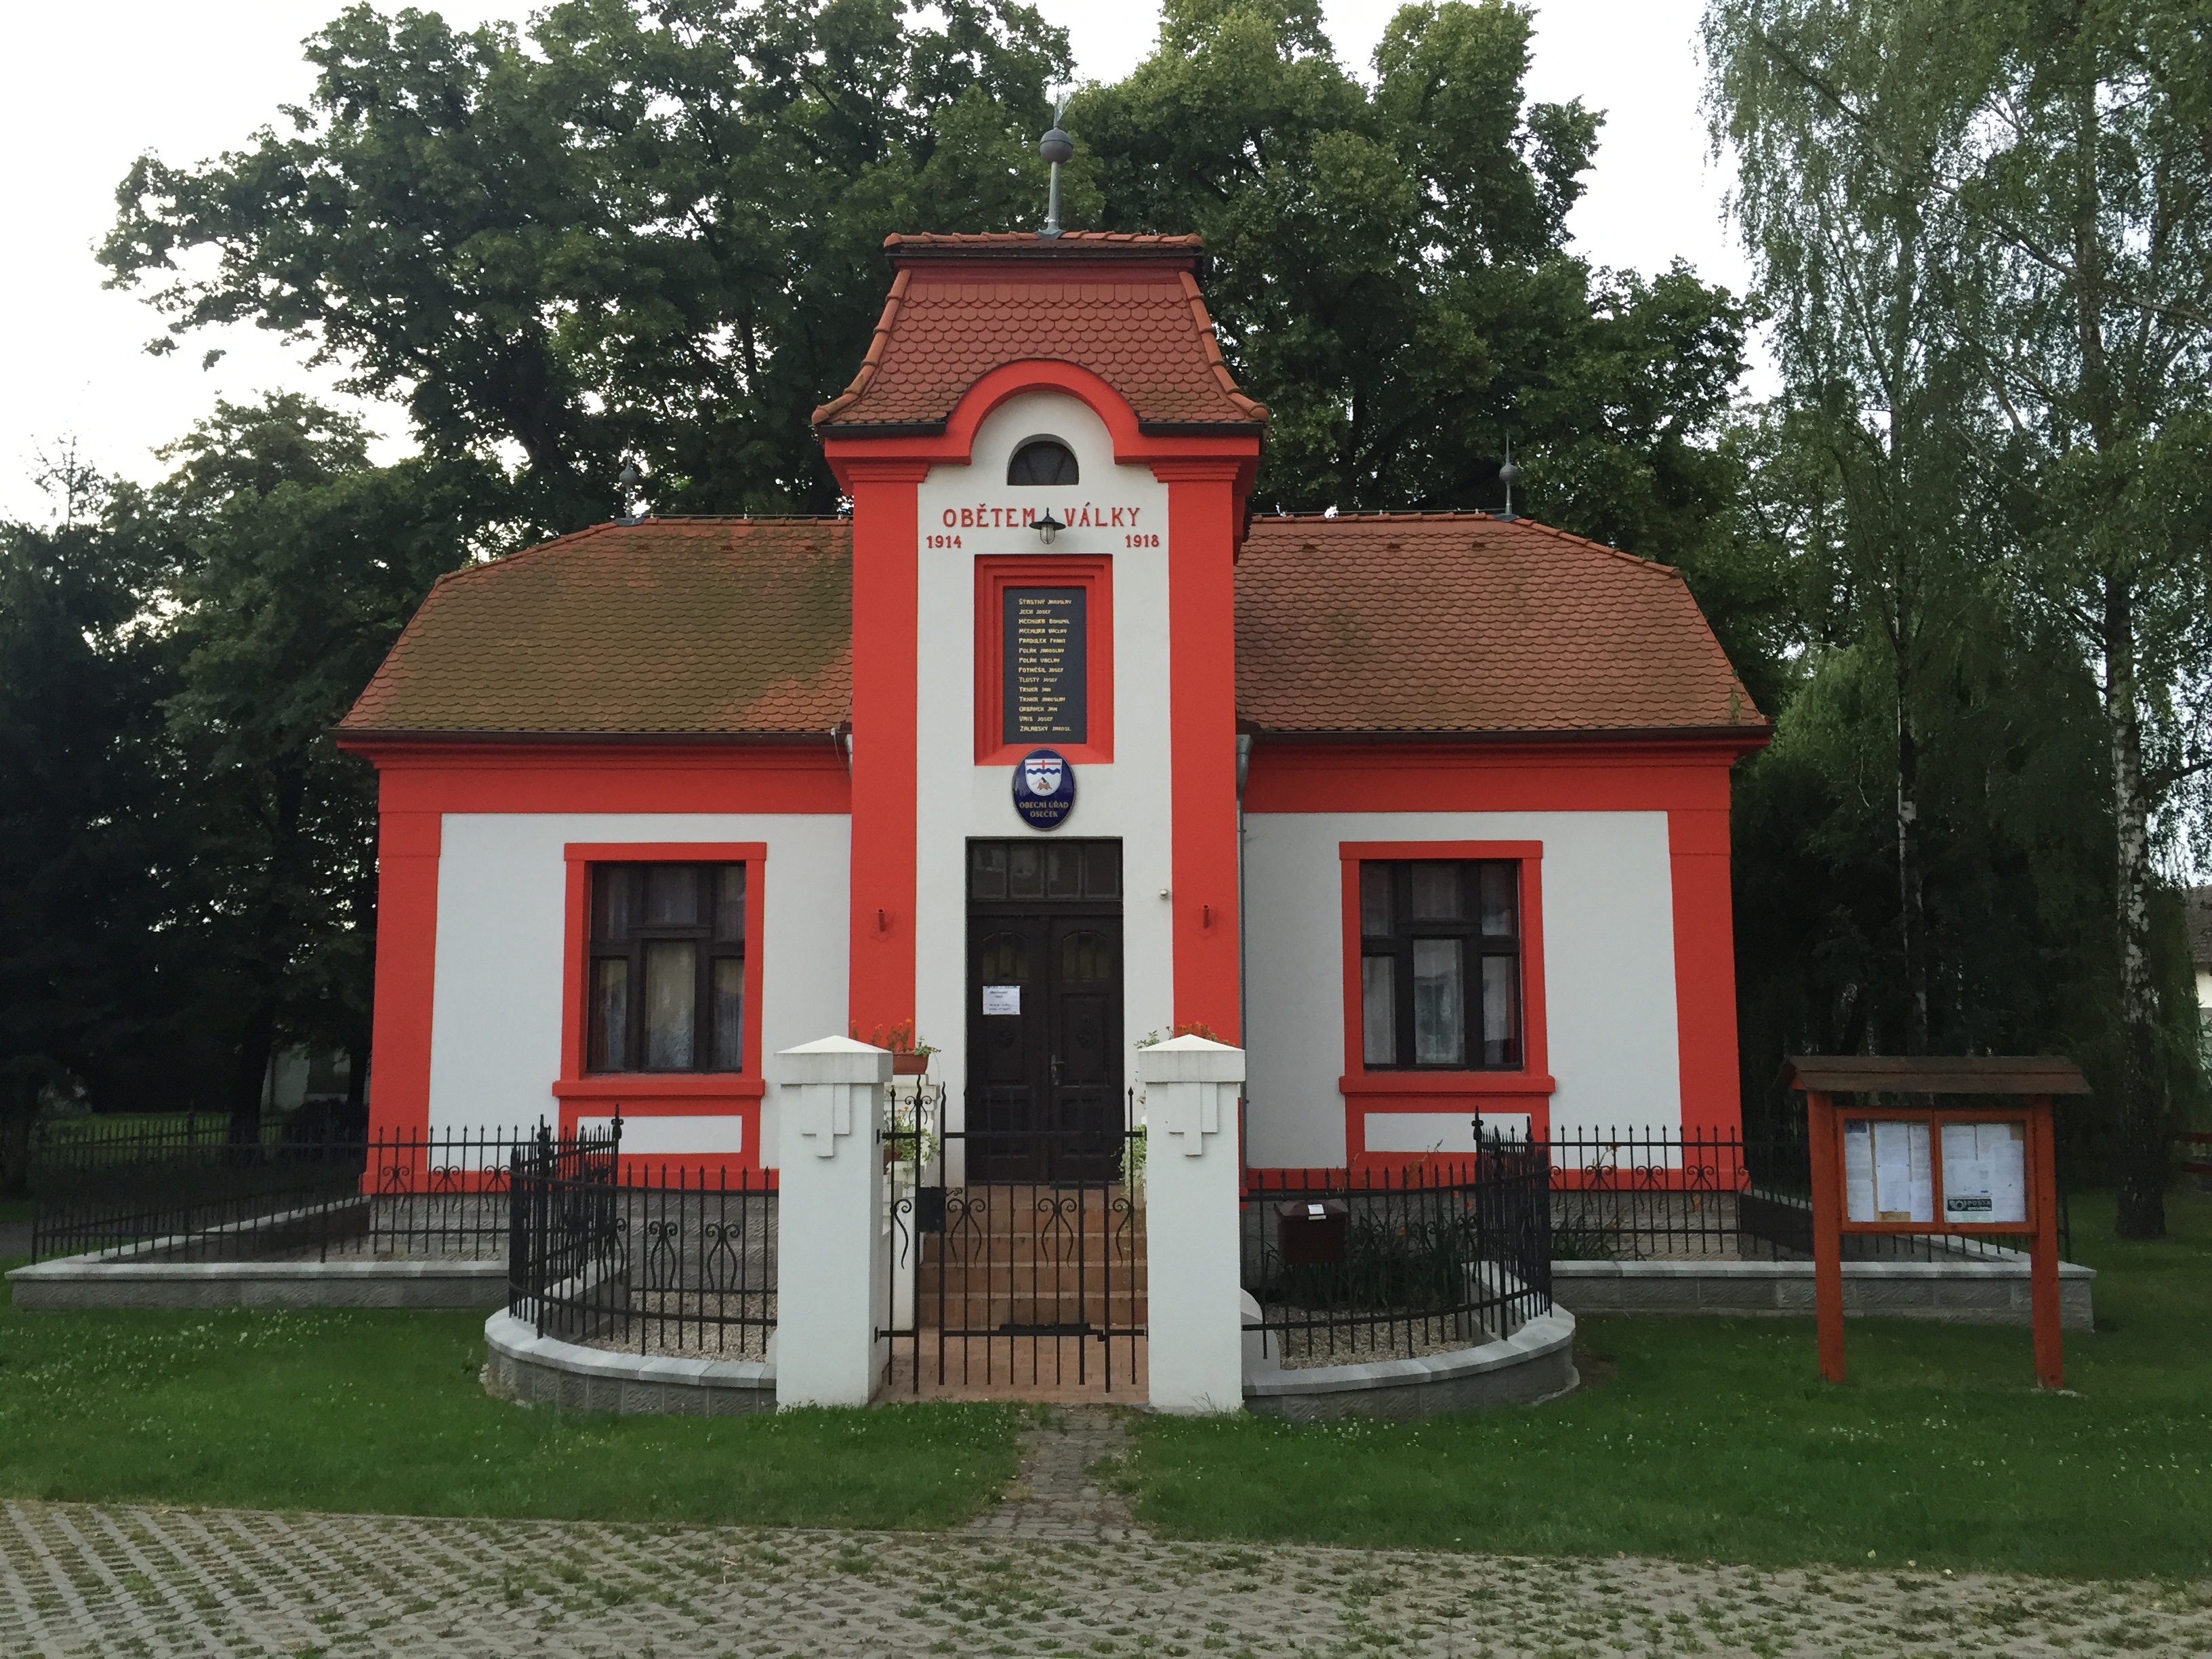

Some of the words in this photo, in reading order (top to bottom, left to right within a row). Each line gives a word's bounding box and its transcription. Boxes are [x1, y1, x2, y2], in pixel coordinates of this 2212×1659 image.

[942, 503, 1036, 528] OBĚTEM
[1063, 501, 1141, 528] VÁLKY
[926, 535, 962, 549] 1914
[1125, 534, 1160, 548] 1918
[1019, 800, 1047, 809] OBECNÍ
[1048, 800, 1069, 809] ÚŘAD
